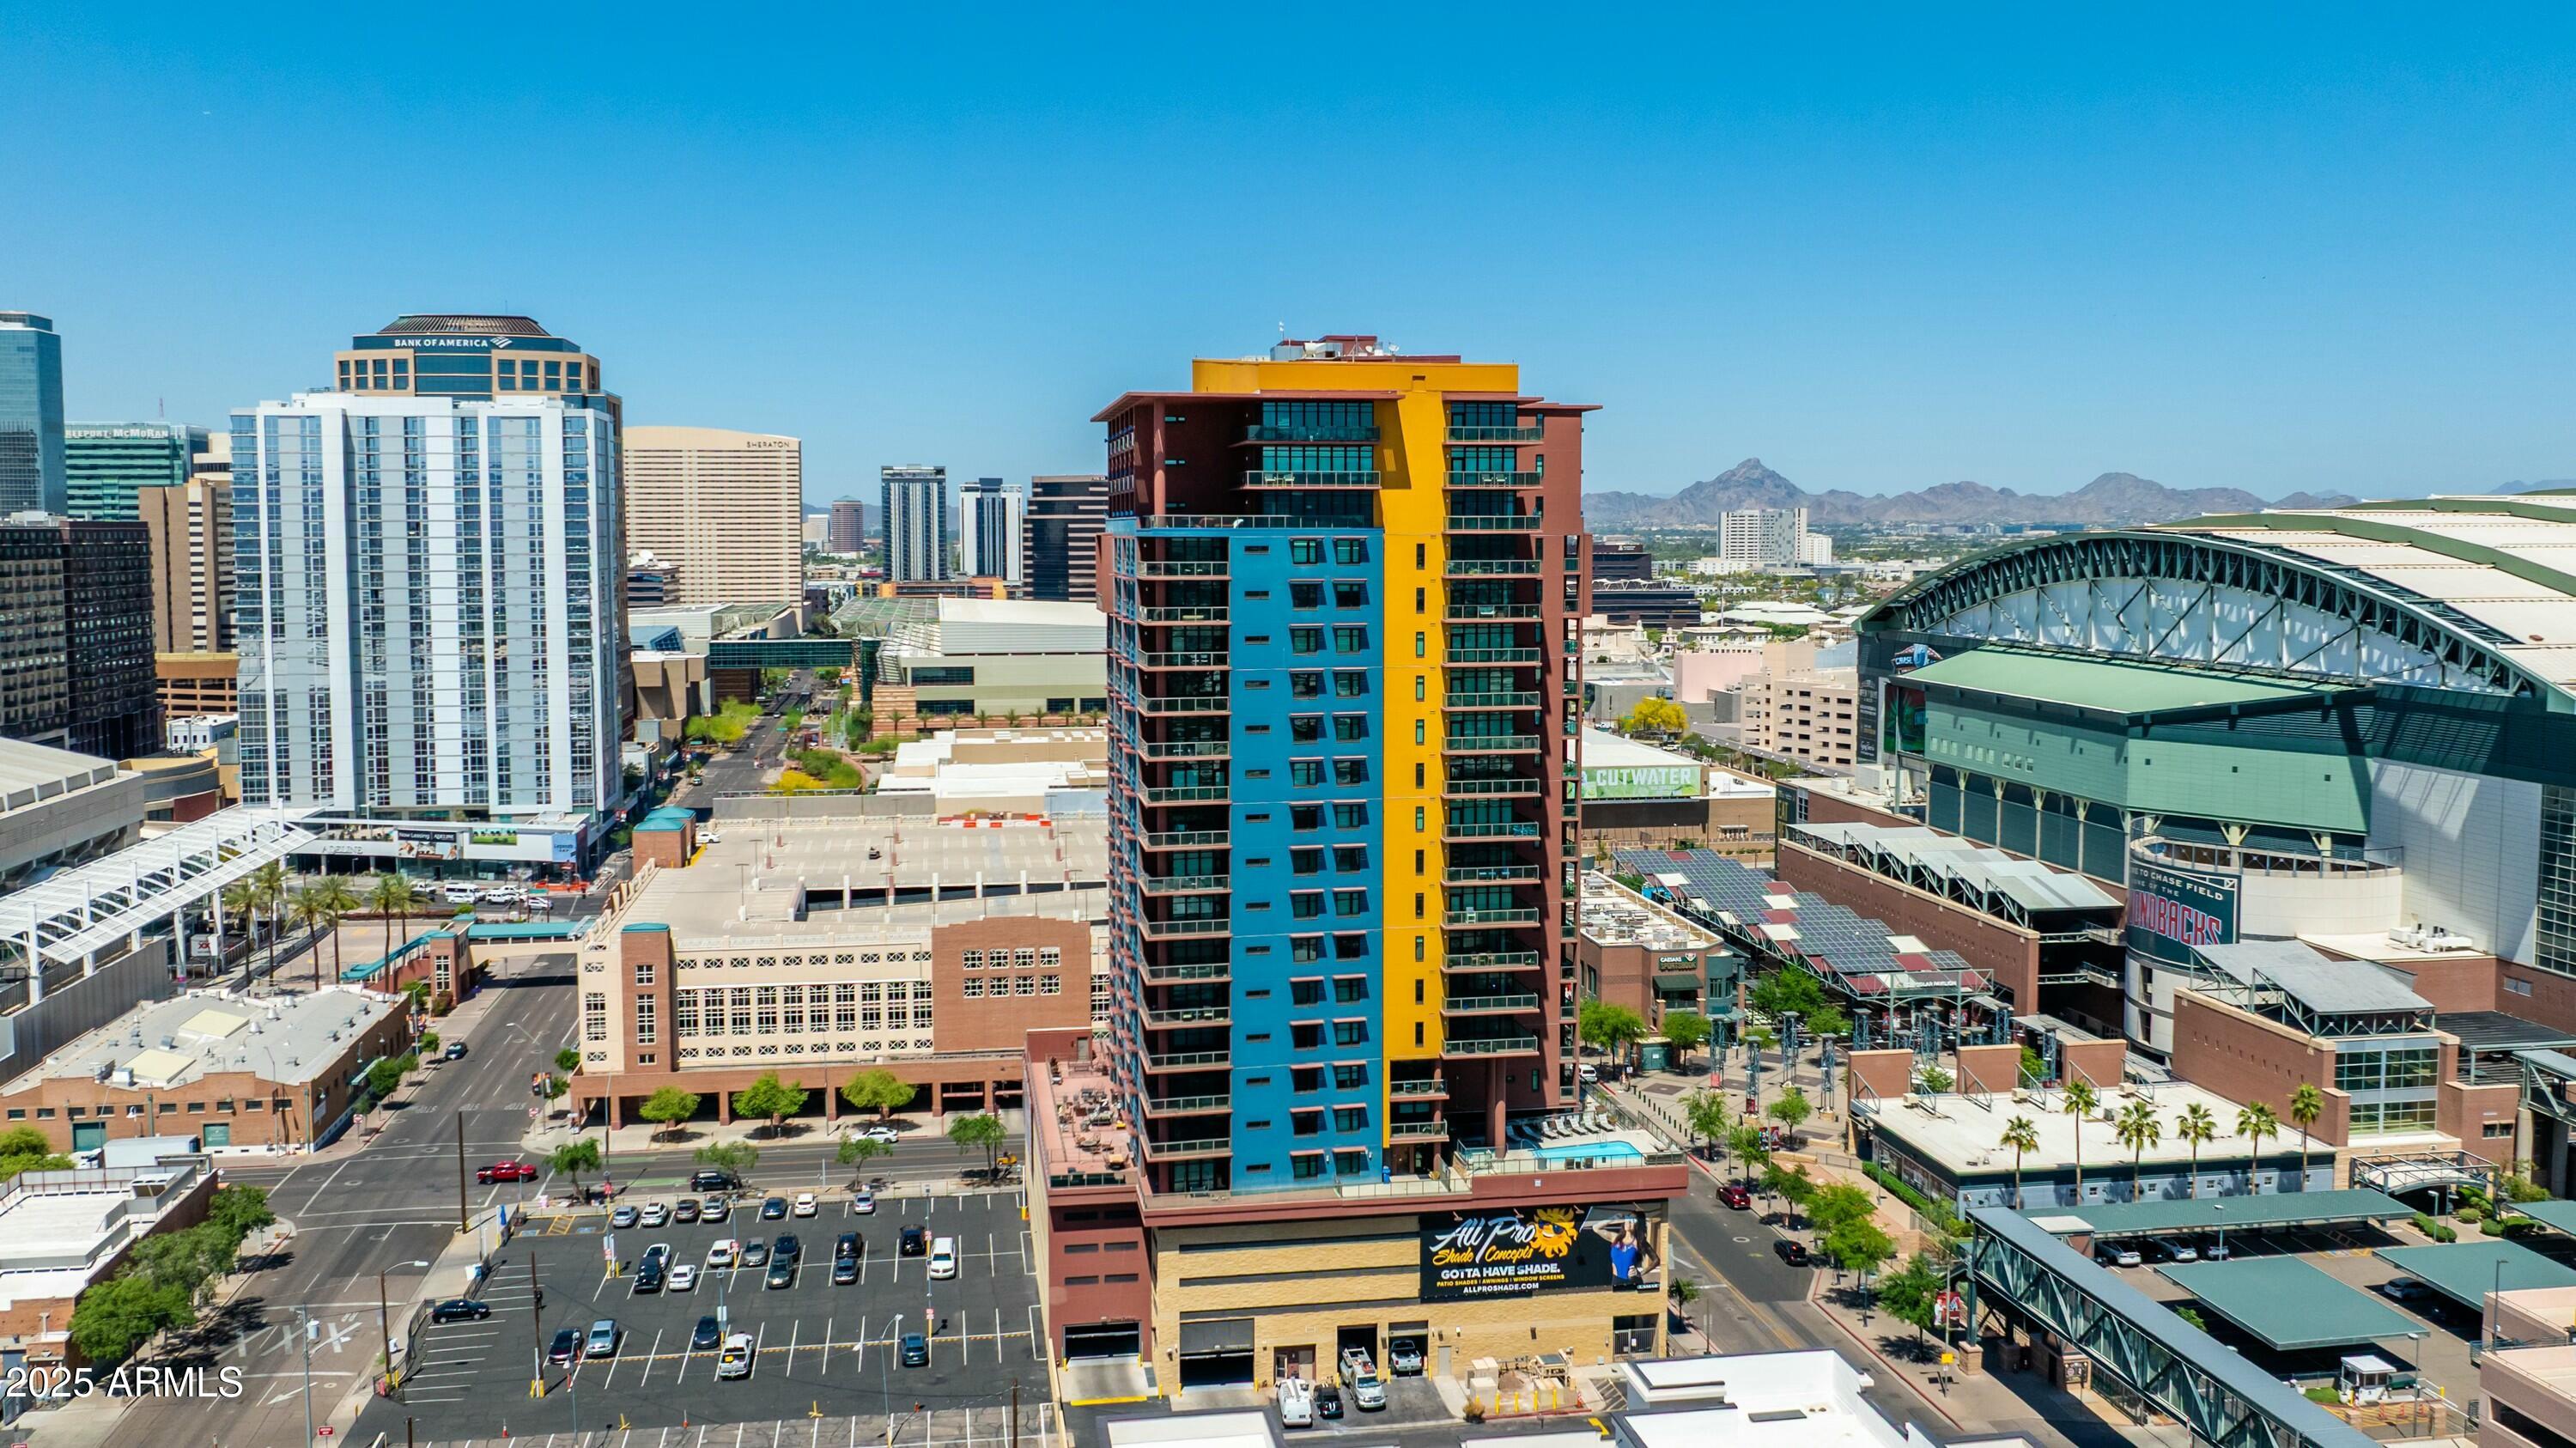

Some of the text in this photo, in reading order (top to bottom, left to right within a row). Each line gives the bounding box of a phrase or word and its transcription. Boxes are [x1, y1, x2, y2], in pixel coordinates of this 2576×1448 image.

[394, 338, 421, 347] BANK
[424, 338, 436, 347] OF
[1596, 767, 1692, 787] CUTWATER
[2150, 872, 2182, 888] CHASE
[2186, 883, 2223, 900] FIELD
[2161, 886, 2180, 897] THE
[2129, 889, 2222, 945] ONDBACKS
[1429, 1217, 1536, 1263] All Pro
[1432, 1244, 1534, 1265] Shade Concepts
[1441, 1263, 1561, 1280] GOTTA HAVE SHADE.
[1463, 1282, 1540, 1293] ALLPROSHADE.COM
